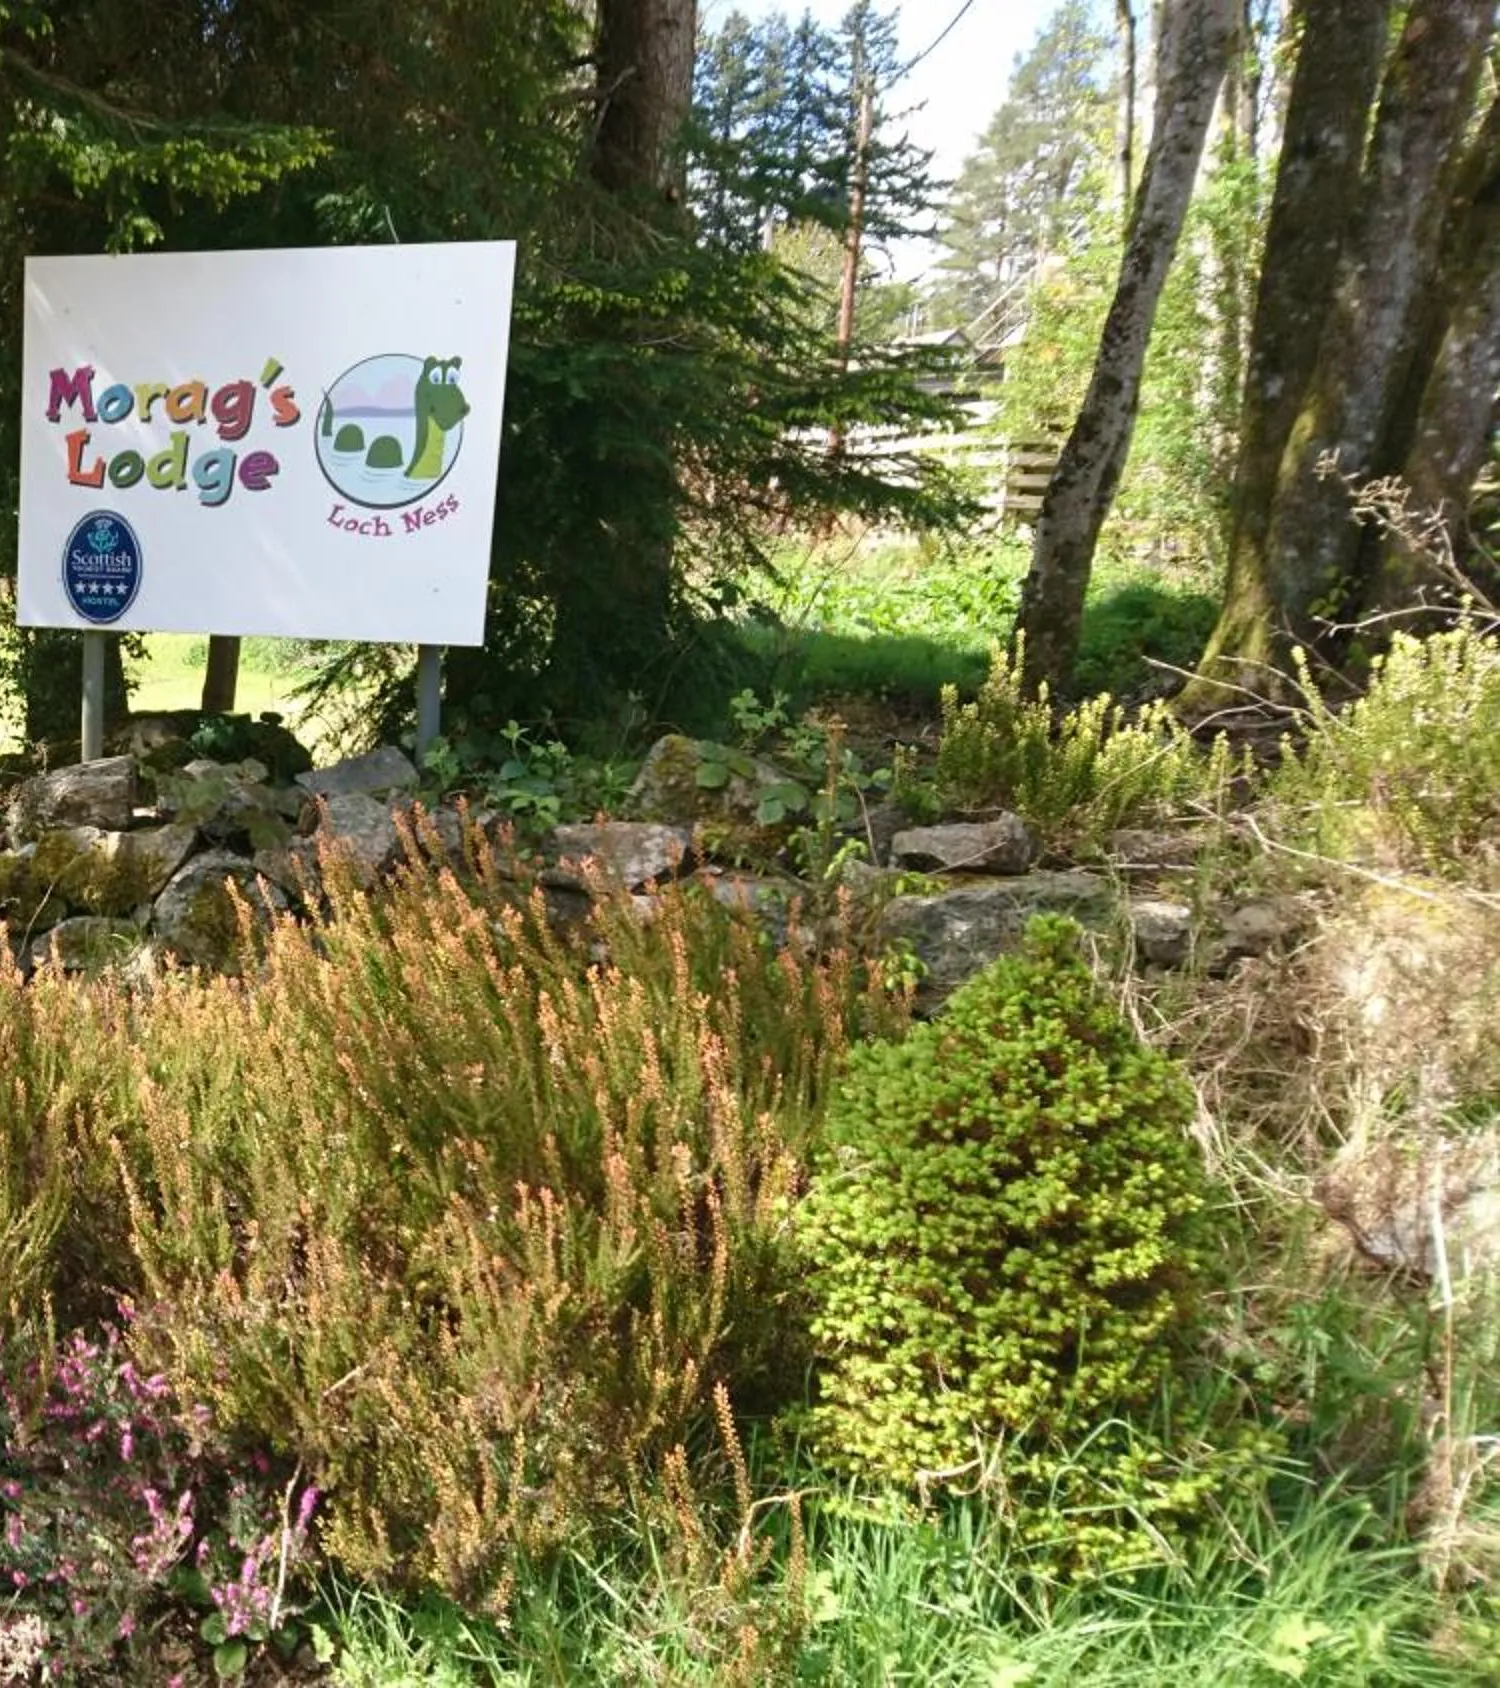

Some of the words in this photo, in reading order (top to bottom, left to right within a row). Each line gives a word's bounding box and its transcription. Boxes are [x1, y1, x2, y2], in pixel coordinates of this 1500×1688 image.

[45, 357, 301, 440] Morag's
[65, 429, 280, 507] Lodge
[327, 504, 393, 537] Loch
[402, 493, 461, 535] Ness
[71, 548, 132, 567] Scottish
